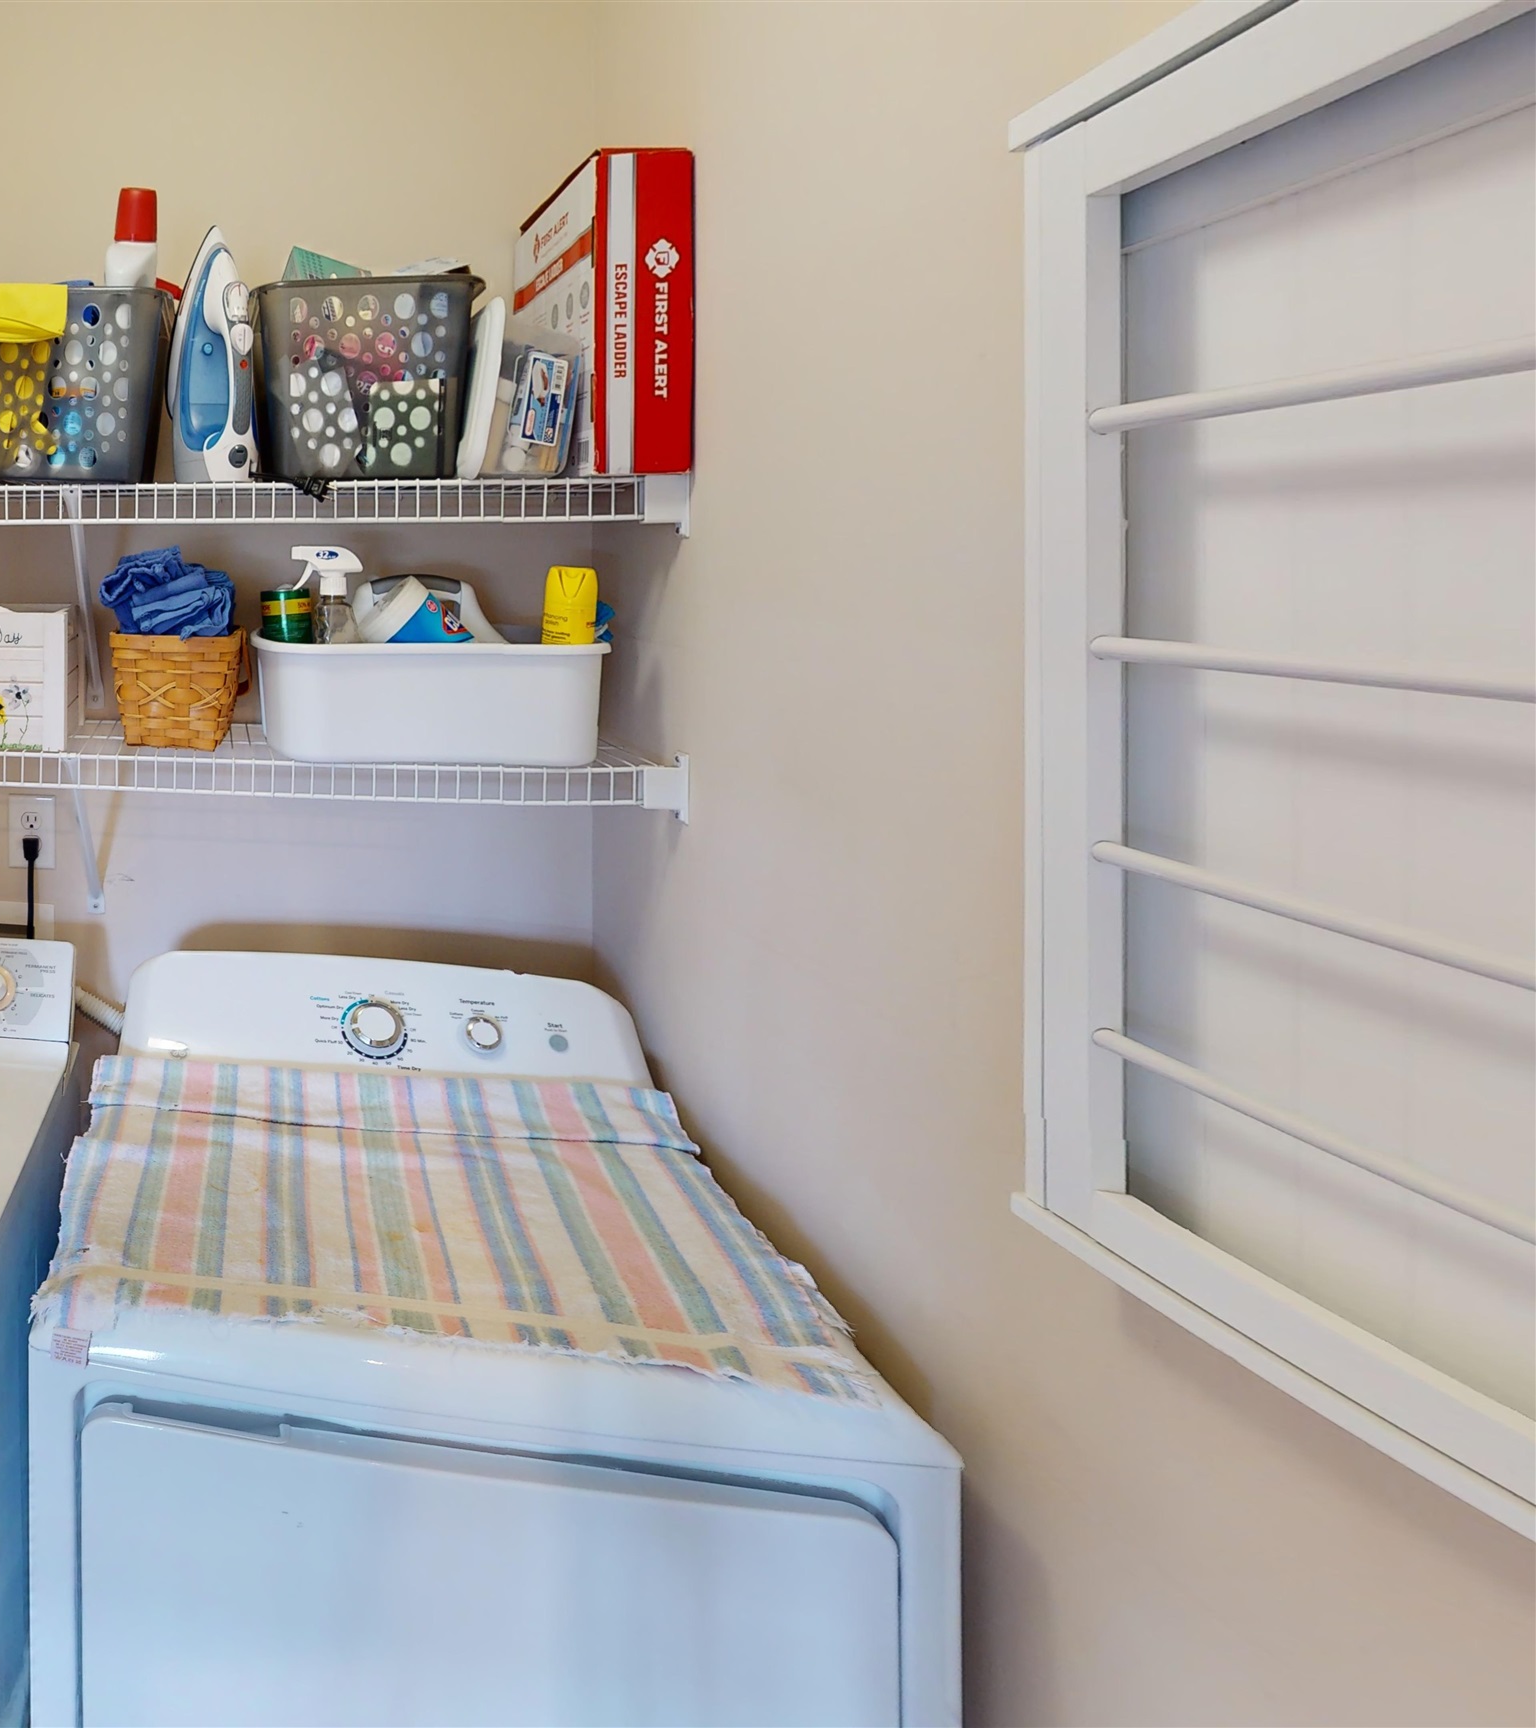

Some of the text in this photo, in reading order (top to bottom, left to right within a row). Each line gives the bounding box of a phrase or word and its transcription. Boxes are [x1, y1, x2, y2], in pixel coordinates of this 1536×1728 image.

[614, 263, 628, 378] ESCAPE LADDER
[654, 281, 669, 398] FIRST ALERT
[317, 551, 329, 559] 32
[459, 998, 495, 1006] Temperature
